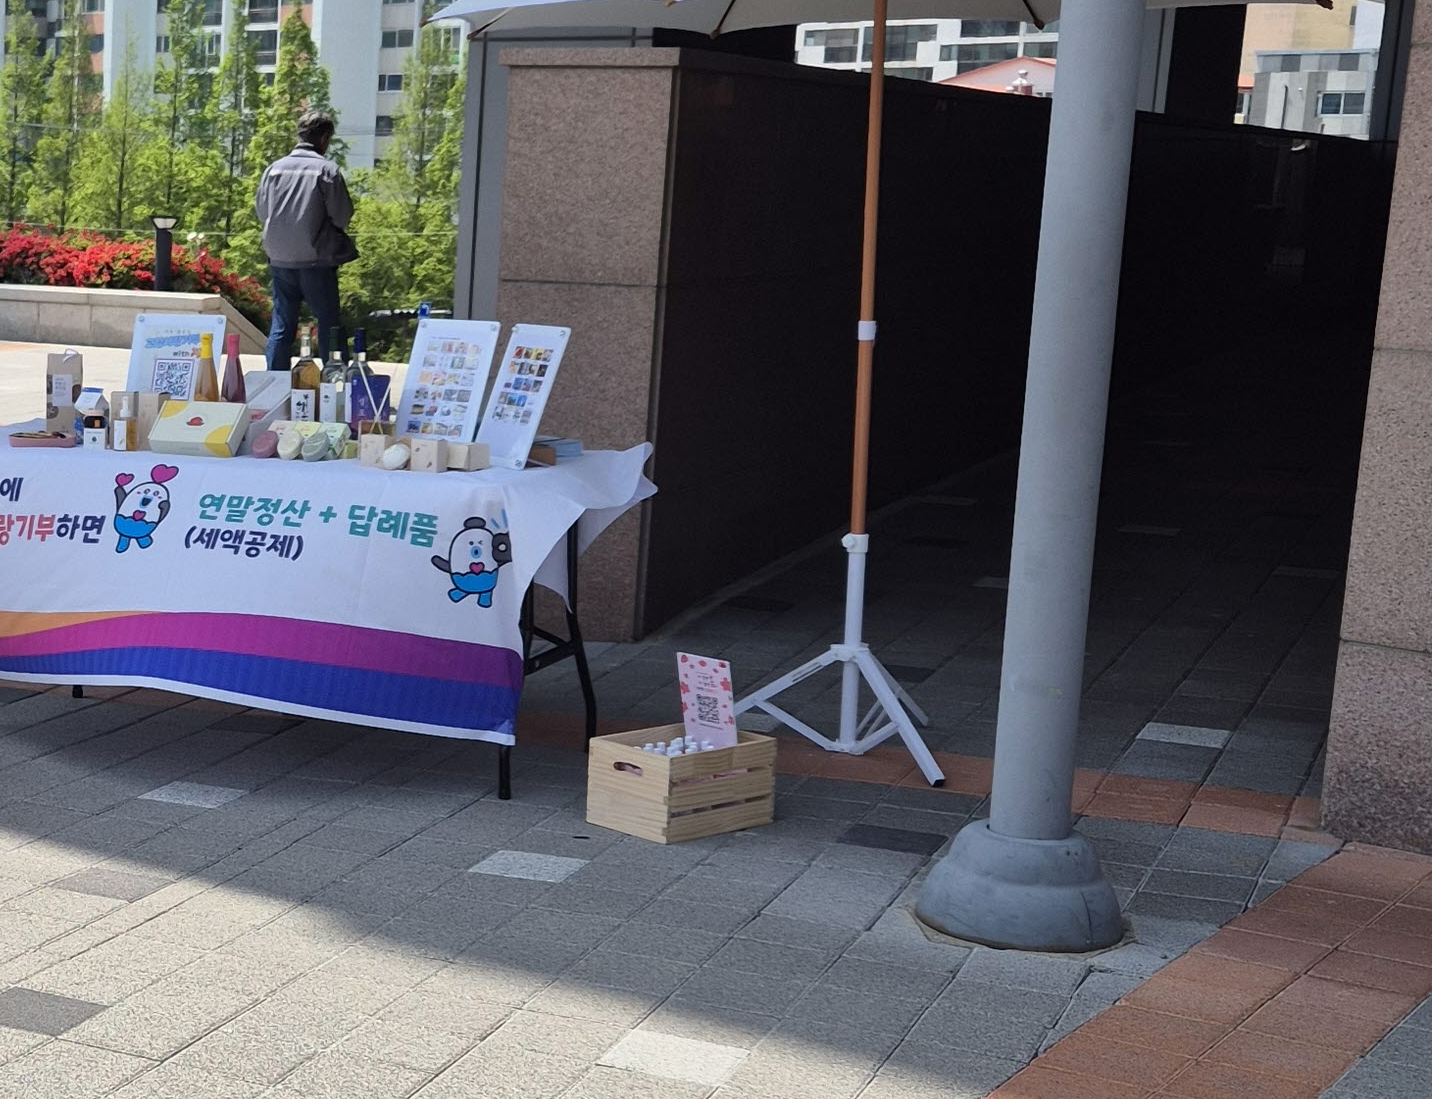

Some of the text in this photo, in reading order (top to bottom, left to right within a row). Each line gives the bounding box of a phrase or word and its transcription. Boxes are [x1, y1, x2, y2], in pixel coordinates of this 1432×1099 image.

[184, 525, 304, 562] (세액공제)
[198, 493, 312, 529] 연말정산
[347, 504, 439, 548] 답례품
